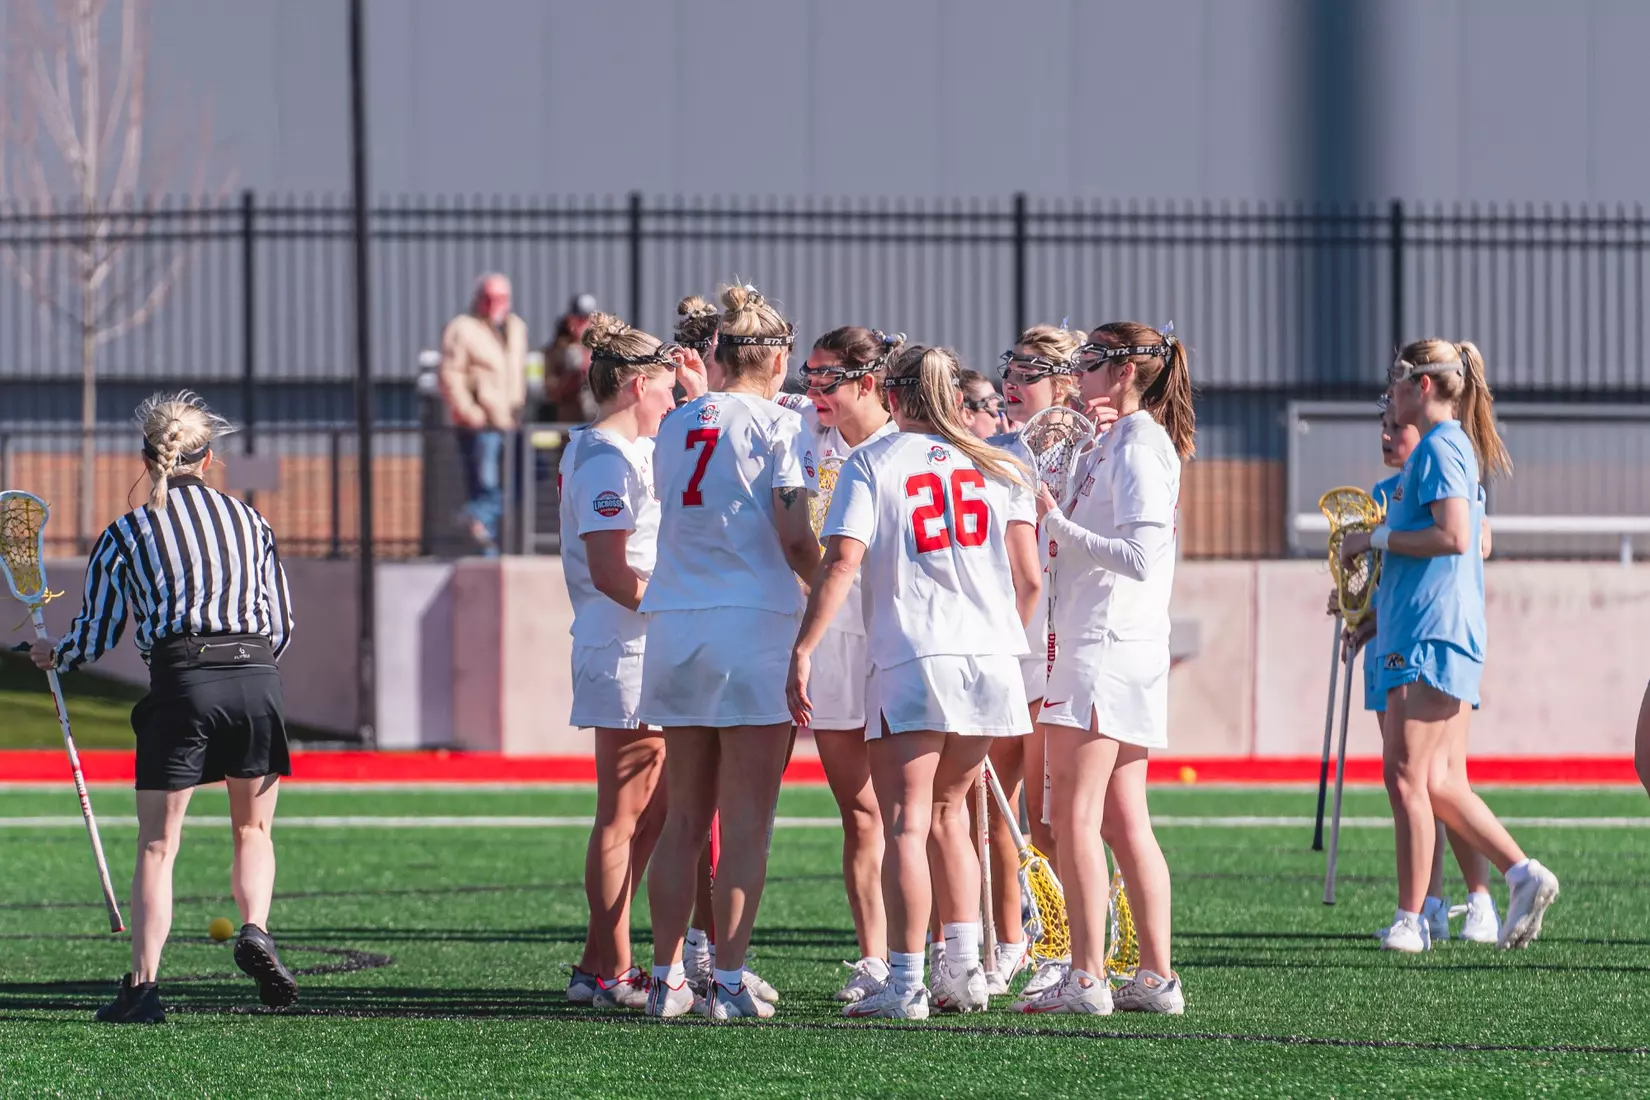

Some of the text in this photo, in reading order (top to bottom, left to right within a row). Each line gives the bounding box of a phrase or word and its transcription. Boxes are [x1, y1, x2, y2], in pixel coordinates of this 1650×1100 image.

[733, 336, 757, 344] STX
[764, 337, 783, 345] STX
[786, 336, 795, 344] ST
[1106, 347, 1130, 356] STX
[1053, 366, 1071, 374] STX
[682, 428, 720, 508] 7
[594, 500, 623, 510] LACROSSE
[905, 468, 989, 554] 26
